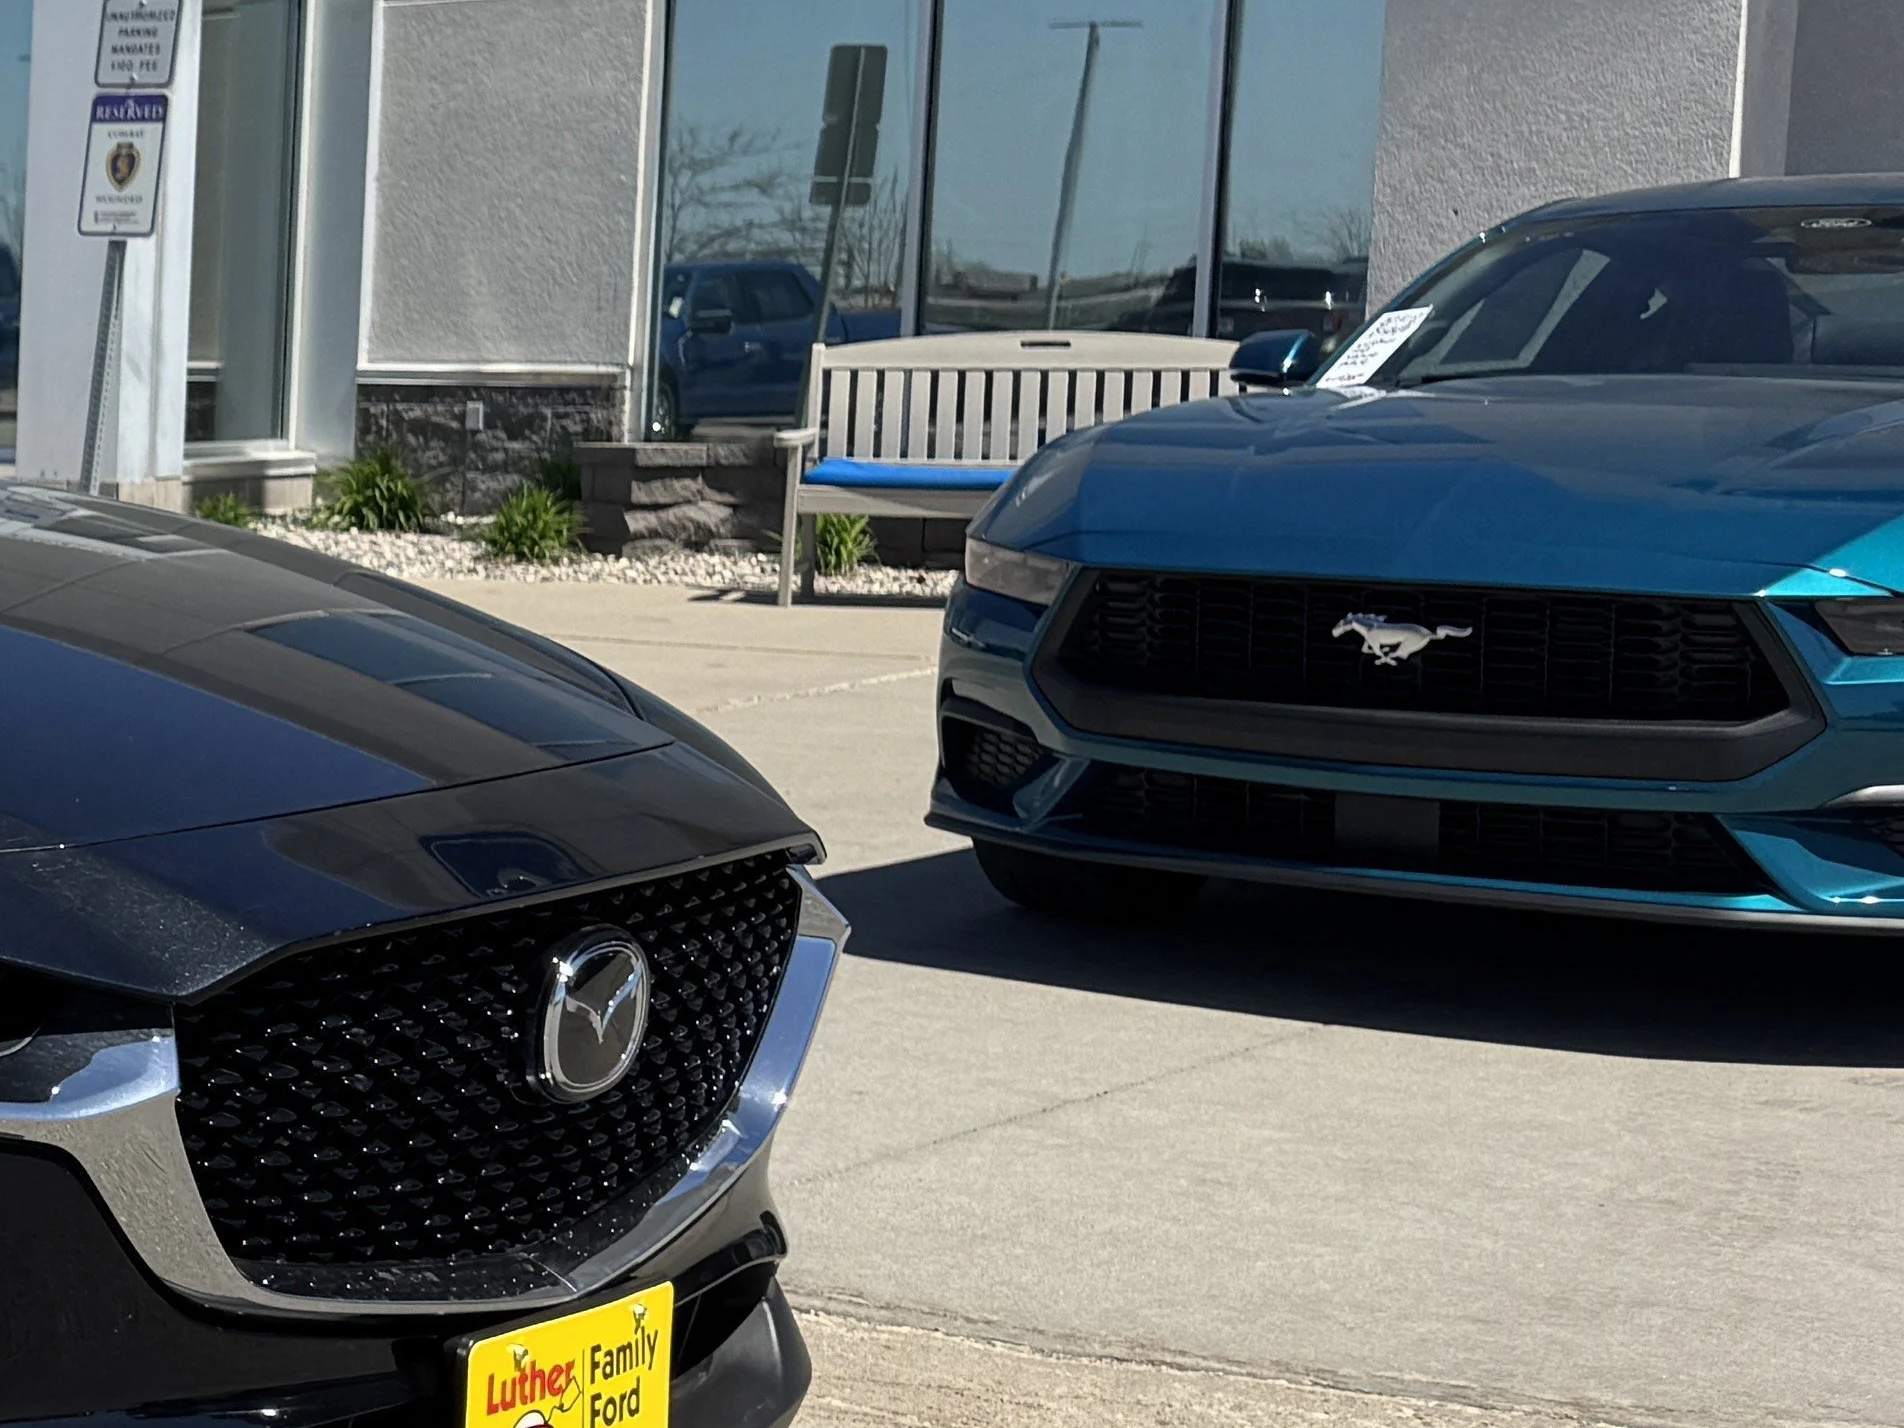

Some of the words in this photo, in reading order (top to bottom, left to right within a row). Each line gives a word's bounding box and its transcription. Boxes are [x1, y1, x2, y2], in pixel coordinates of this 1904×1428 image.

[104, 9, 176, 22] UNAUTHORIZED
[118, 27, 158, 39] PARKING
[111, 43, 160, 55] MANDATES
[96, 103, 164, 120] RESERVED
[589, 1325, 659, 1385] Family
[486, 1358, 576, 1417] Luther
